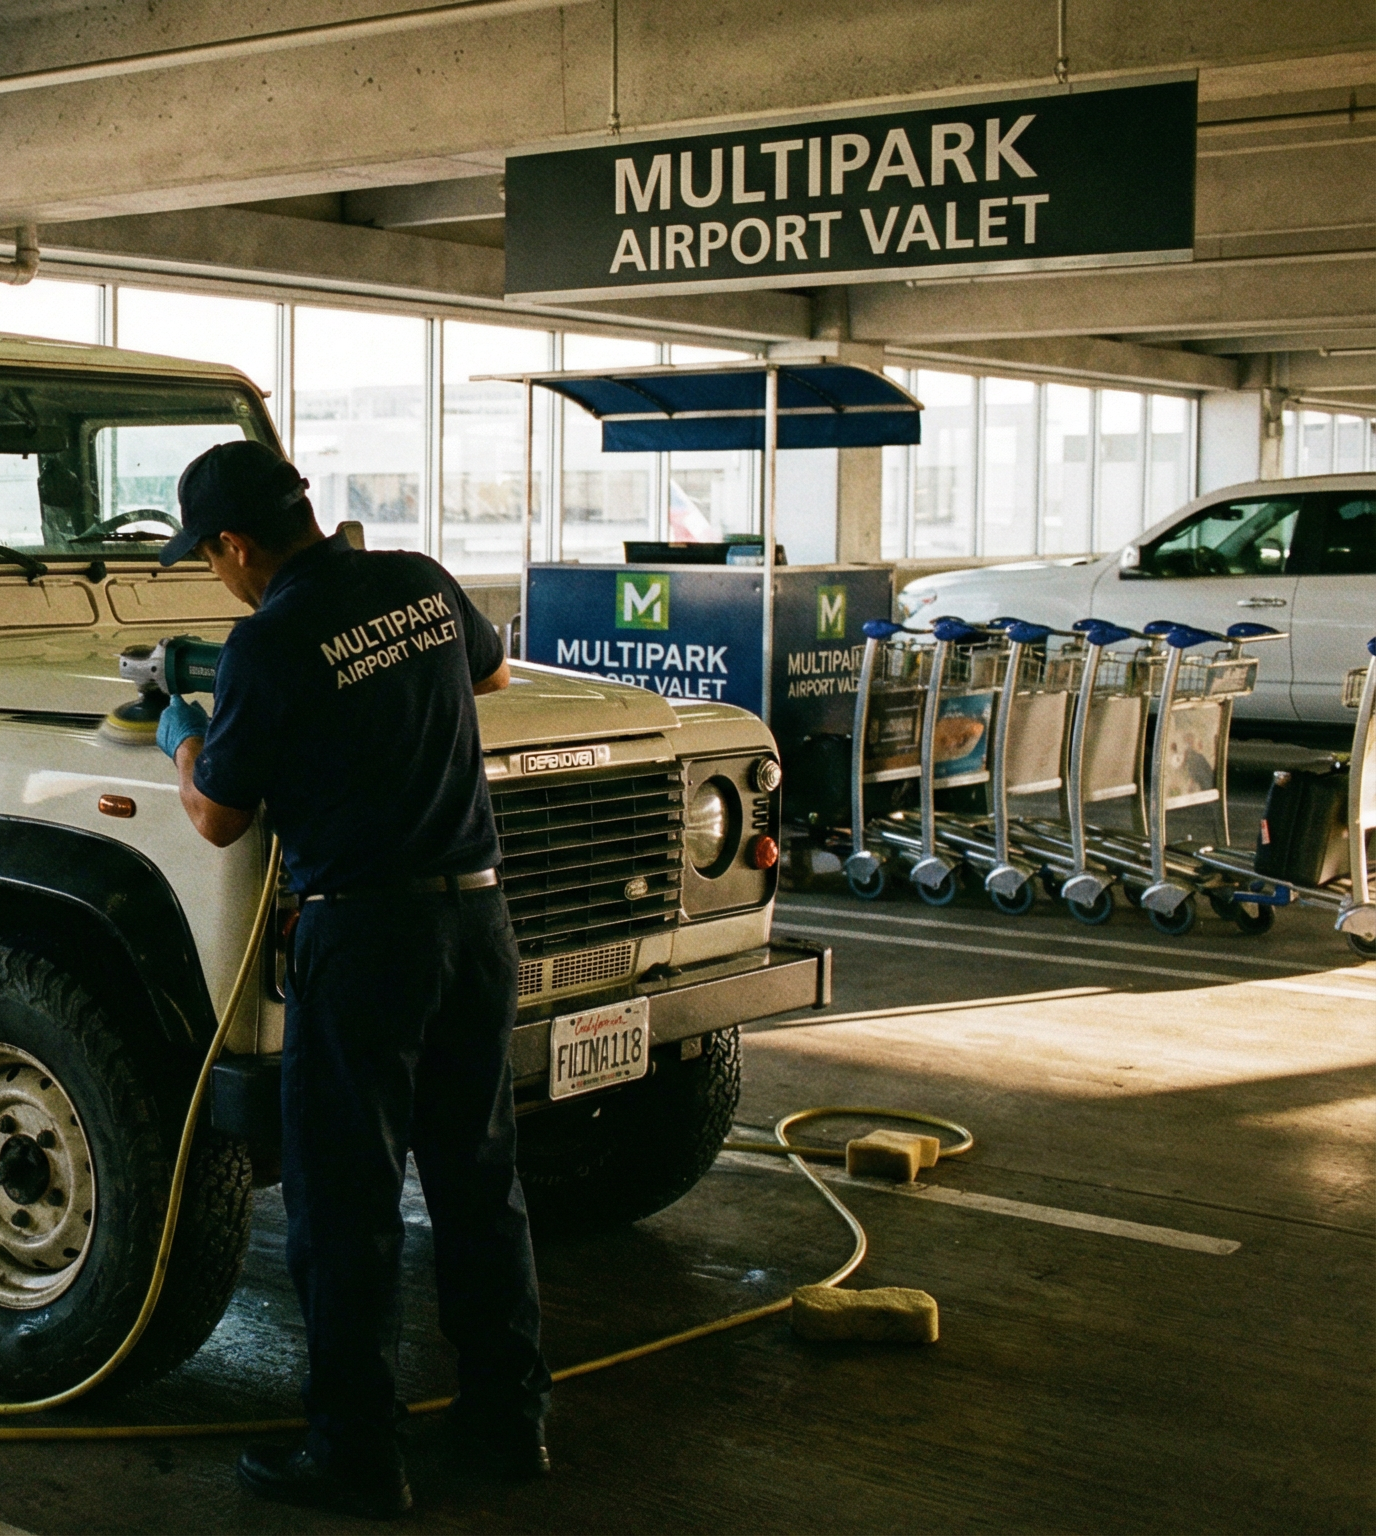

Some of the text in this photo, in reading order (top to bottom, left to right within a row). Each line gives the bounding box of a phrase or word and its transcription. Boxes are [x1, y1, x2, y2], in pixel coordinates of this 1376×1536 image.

[614, 114, 1038, 215] MULTIPARK
[609, 193, 1050, 274] AIRPORT VALET
[623, 582, 662, 623] M
[820, 593, 844, 632] M
[320, 592, 452, 666] MULTIPARK
[337, 620, 458, 689] AIRPORT VALET
[557, 638, 728, 674] MULTIPARK
[788, 647, 860, 676] MULTIPA
[654, 675, 727, 700] VALET
[788, 678, 835, 698] AIRPORT
